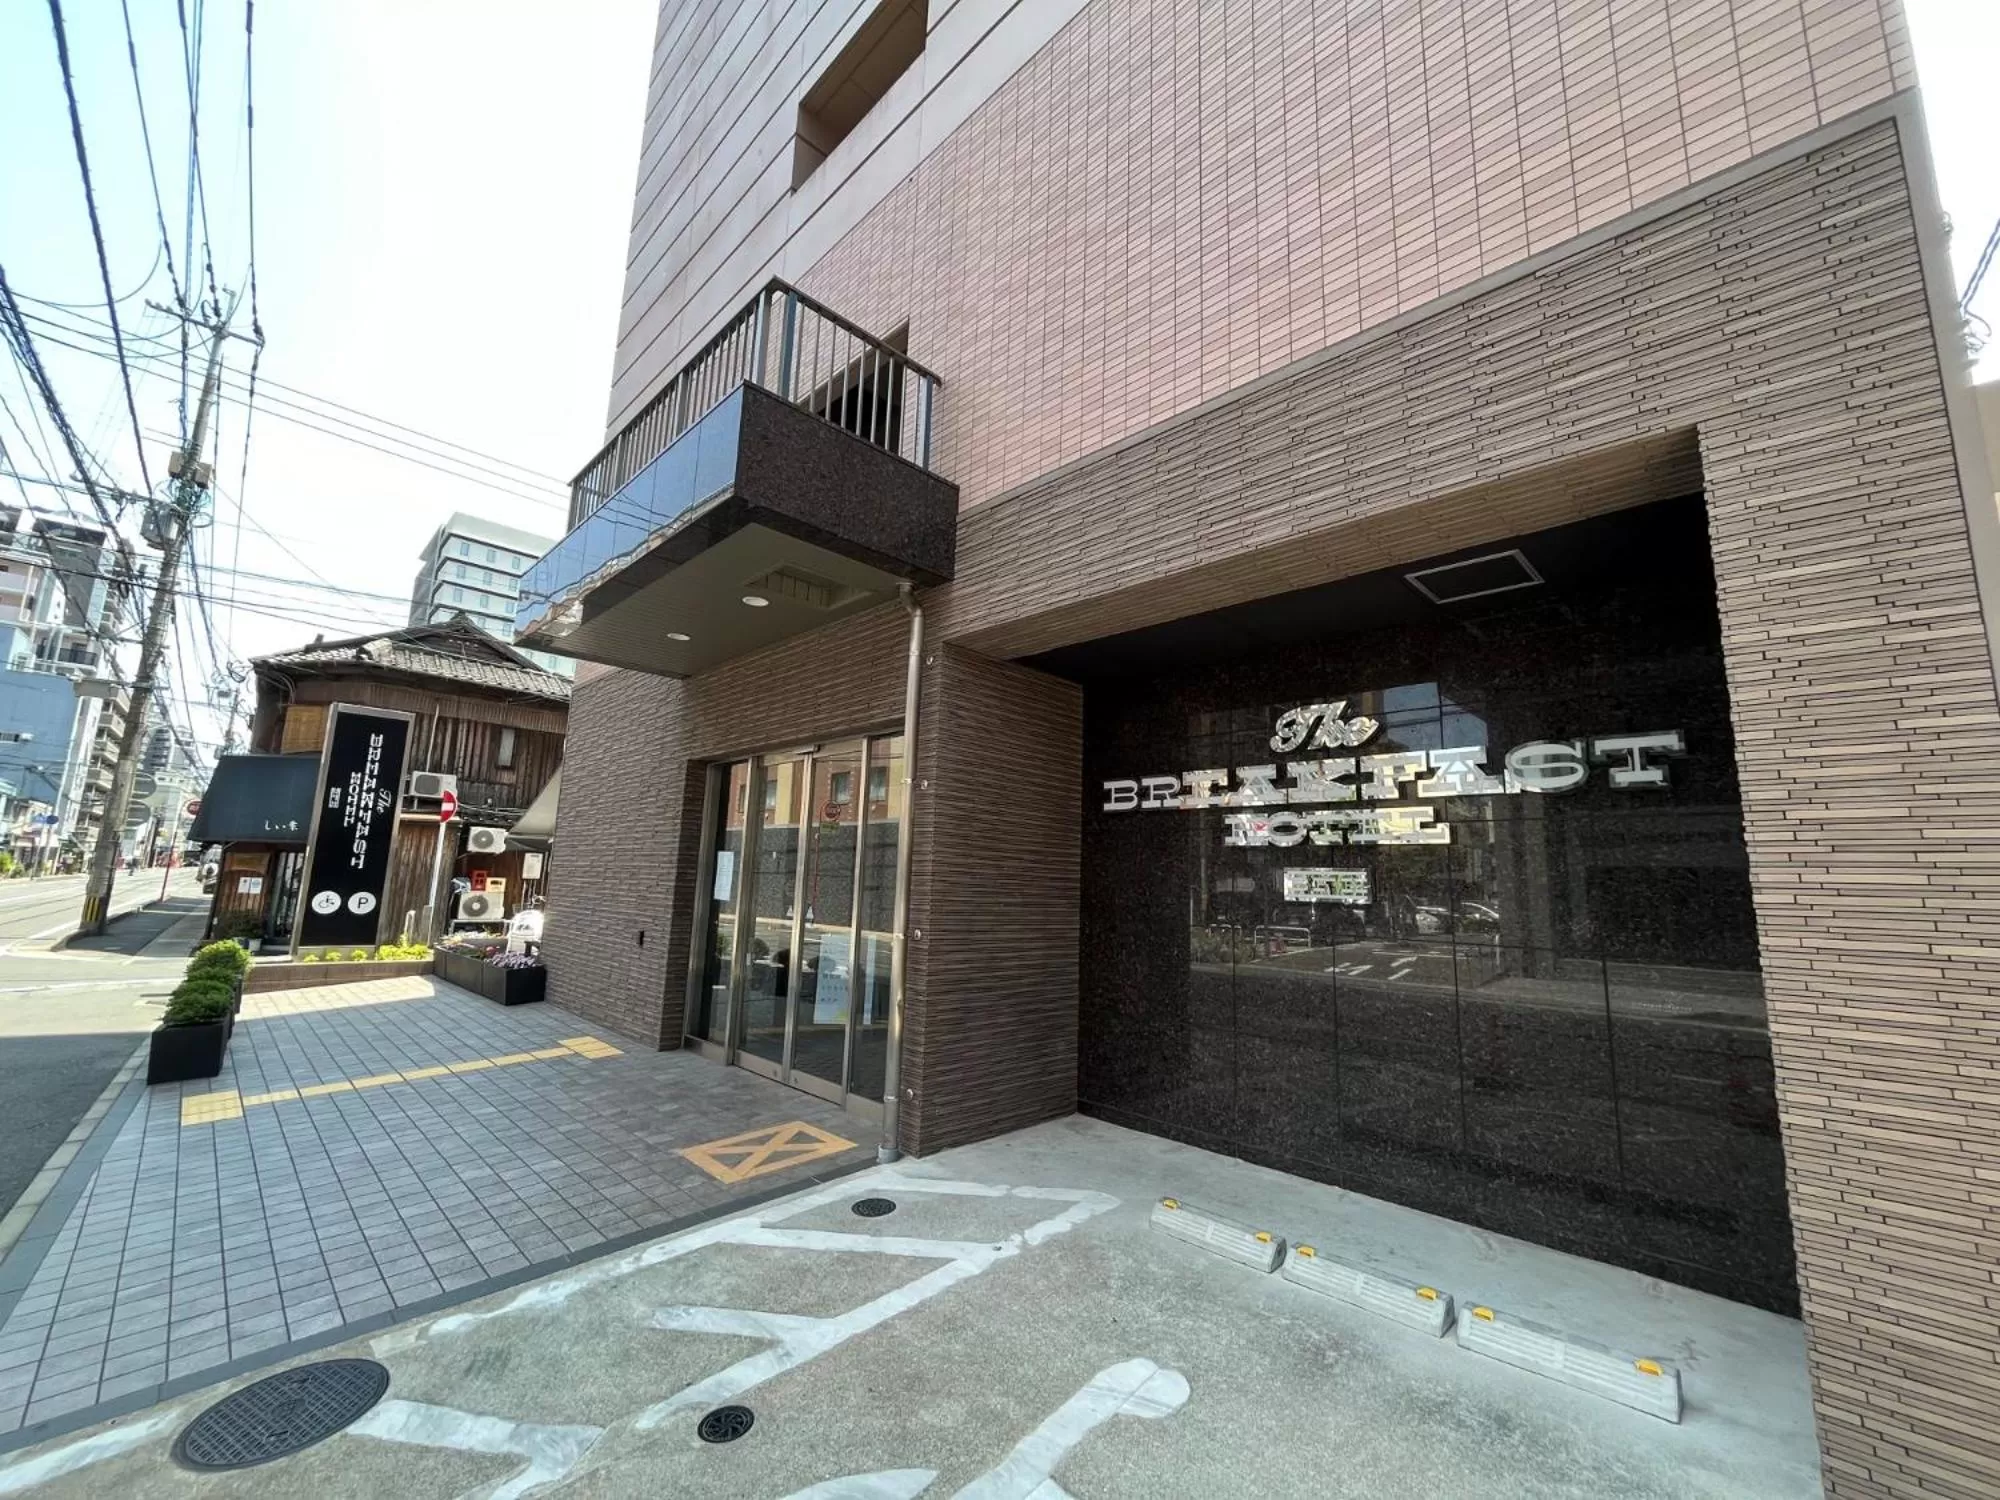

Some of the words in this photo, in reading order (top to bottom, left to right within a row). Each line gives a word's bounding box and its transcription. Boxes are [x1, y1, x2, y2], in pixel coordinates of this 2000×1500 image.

[1270, 700, 1378, 754] The
[1103, 731, 1683, 811] BREAKFAST
[343, 771, 362, 828] HOTEL
[350, 732, 384, 869] BREAKFAST
[376, 787, 392, 815] The
[1224, 806, 1450, 847] HOTEL
[357, 897, 368, 909] P
